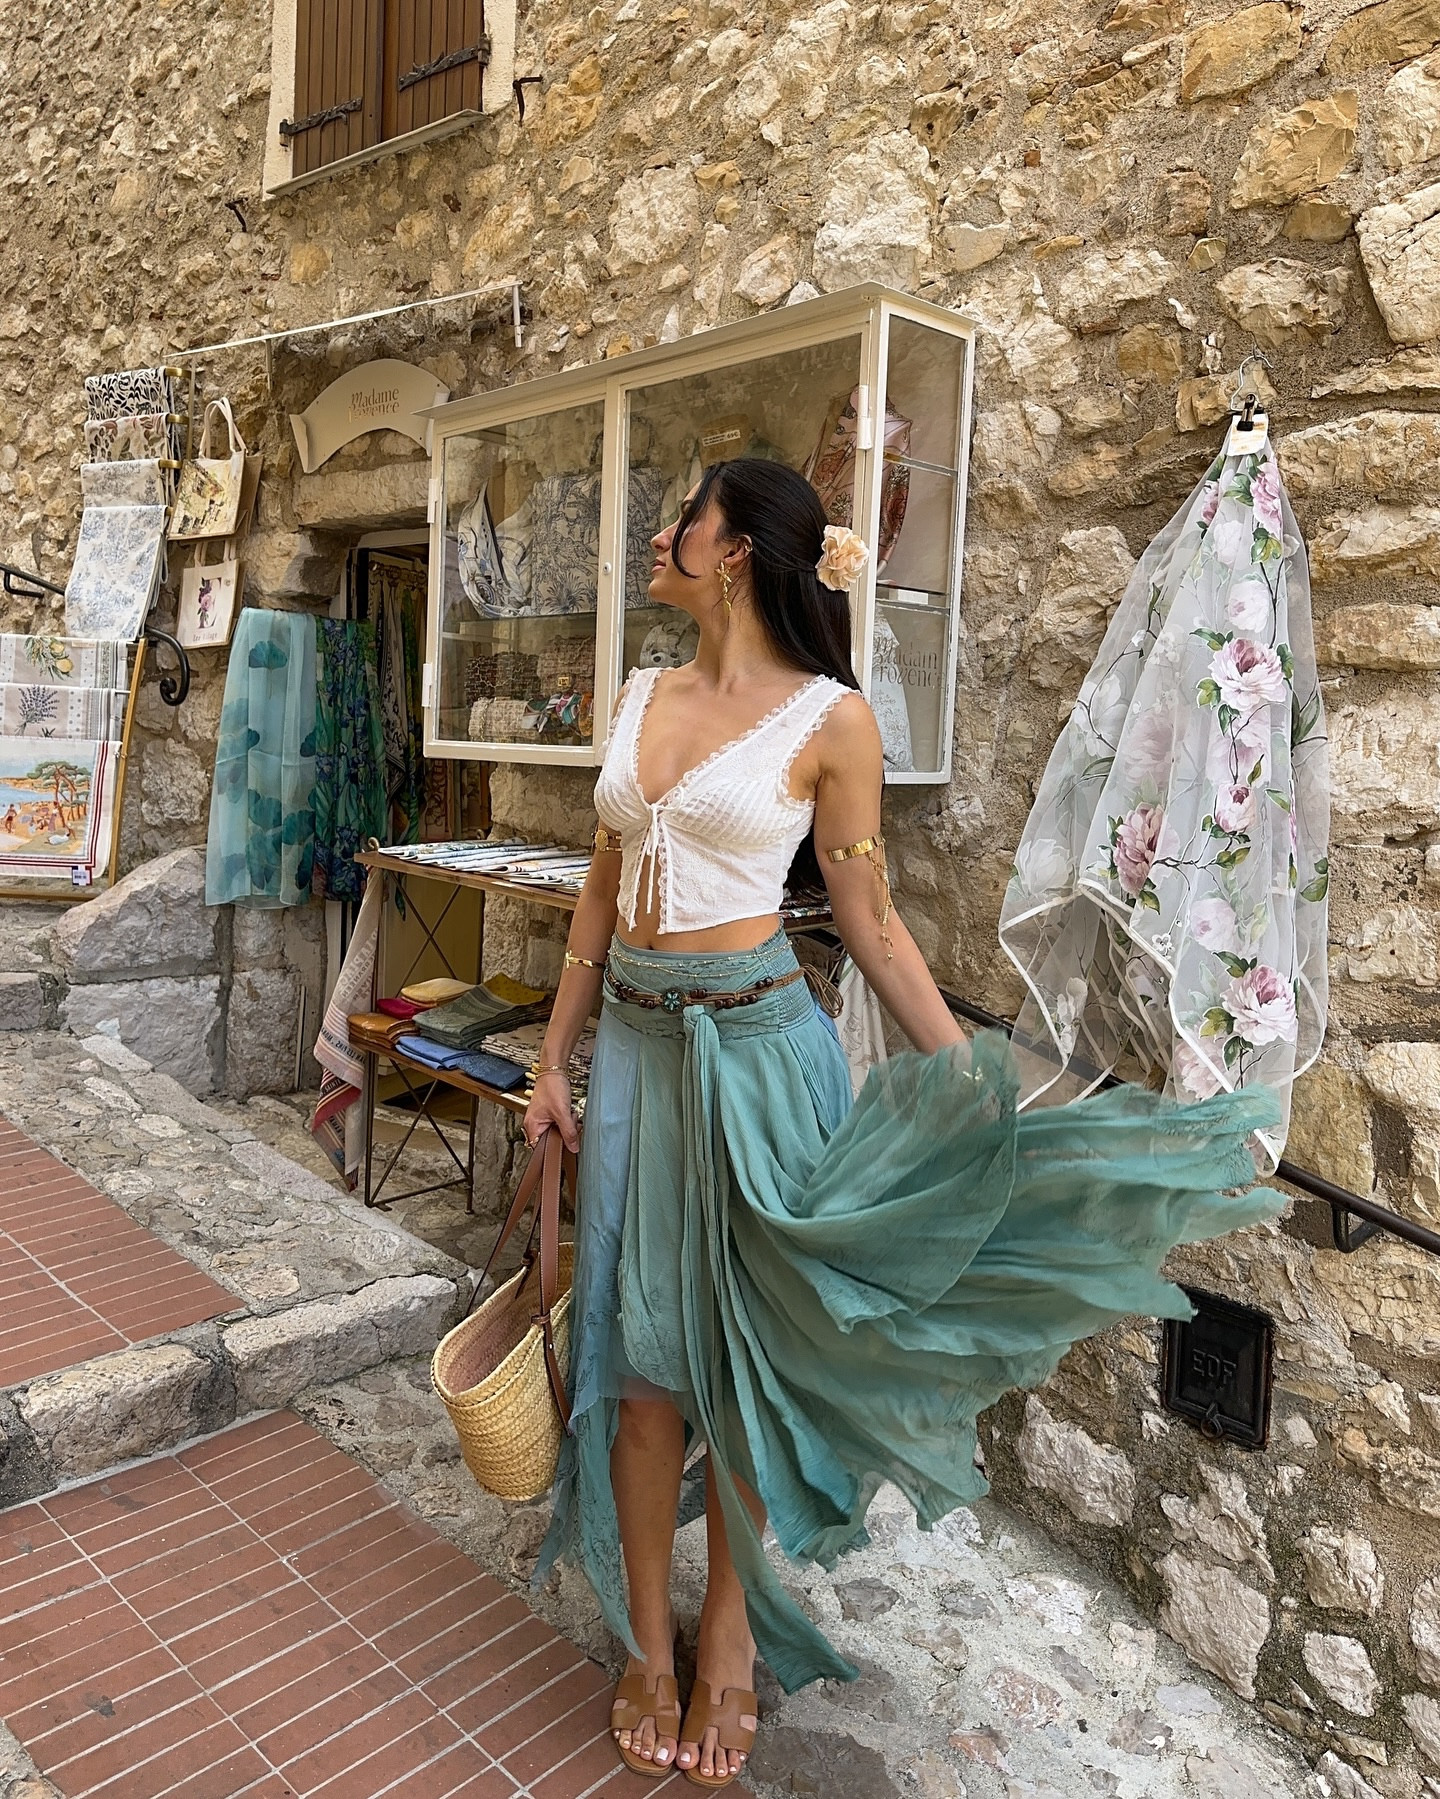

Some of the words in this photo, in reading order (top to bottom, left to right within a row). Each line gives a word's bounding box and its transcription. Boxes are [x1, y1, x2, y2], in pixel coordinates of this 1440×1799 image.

[351, 388, 400, 408] Madame
[874, 636, 937, 669] Madam
[877, 659, 945, 690] rovenc
[1192, 1348, 1237, 1385] EDF
